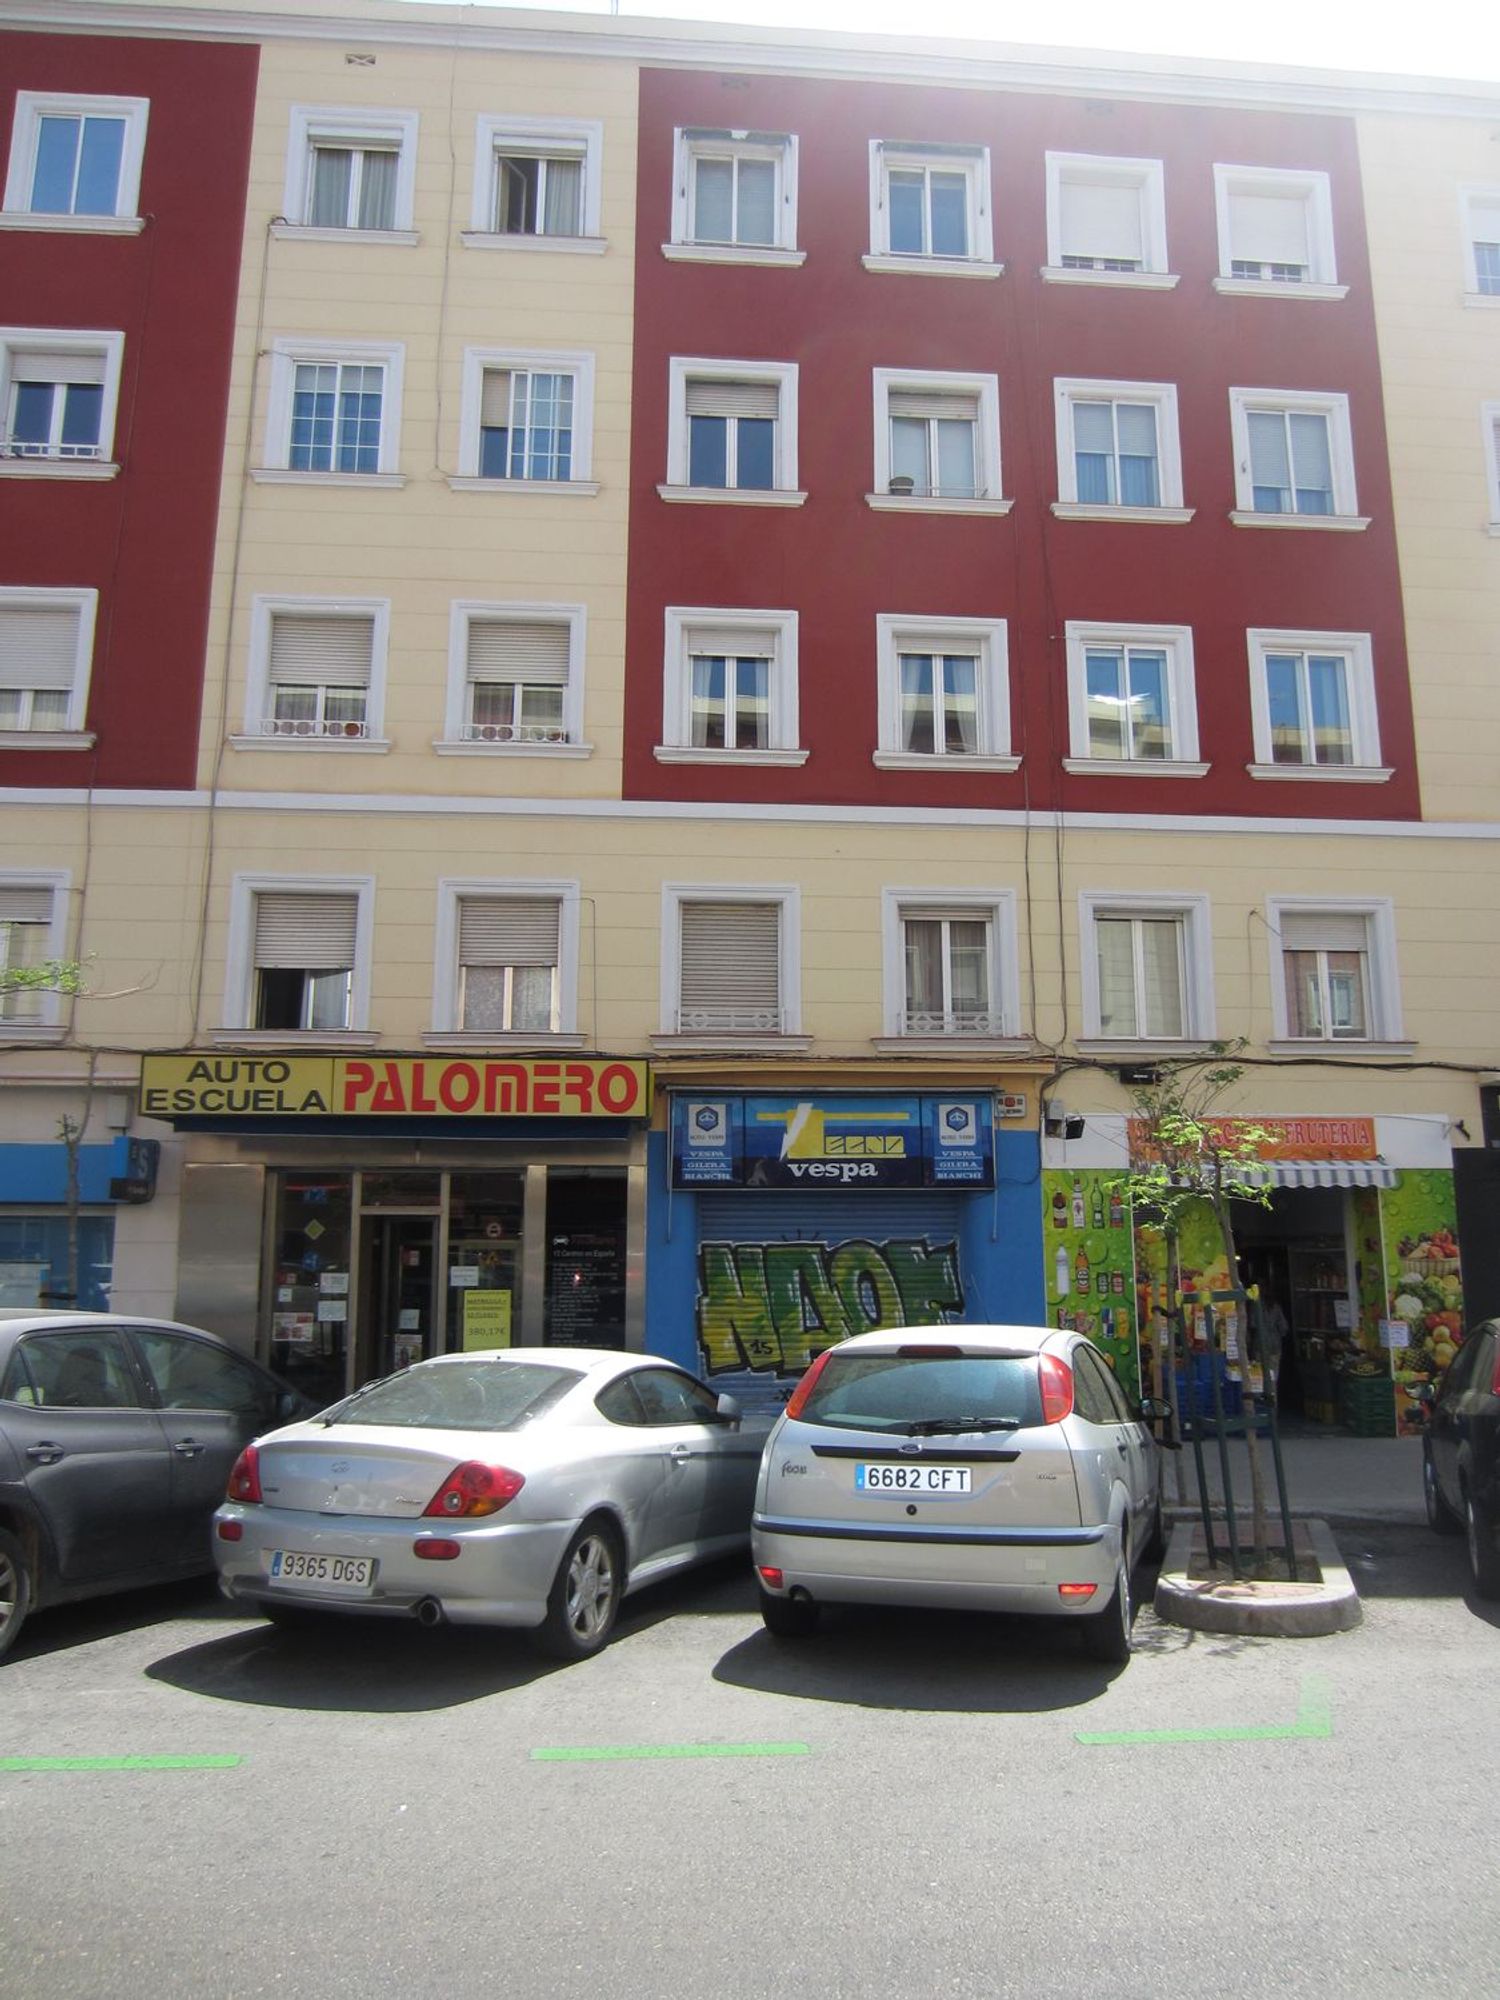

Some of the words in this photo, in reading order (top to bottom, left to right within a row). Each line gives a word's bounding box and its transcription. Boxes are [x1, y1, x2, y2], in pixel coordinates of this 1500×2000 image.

[186, 1061, 290, 1083] AUTO
[344, 1063, 638, 1113] PALOMERO
[146, 1089, 327, 1111] ESCUELA
[1285, 1122, 1370, 1145] FRUTERIA
[788, 1162, 878, 1181] vespa
[868, 1468, 921, 1488] 6682
[928, 1469, 967, 1490] CFT
[284, 1555, 327, 1578] 9365
[333, 1560, 366, 1583] DGS
